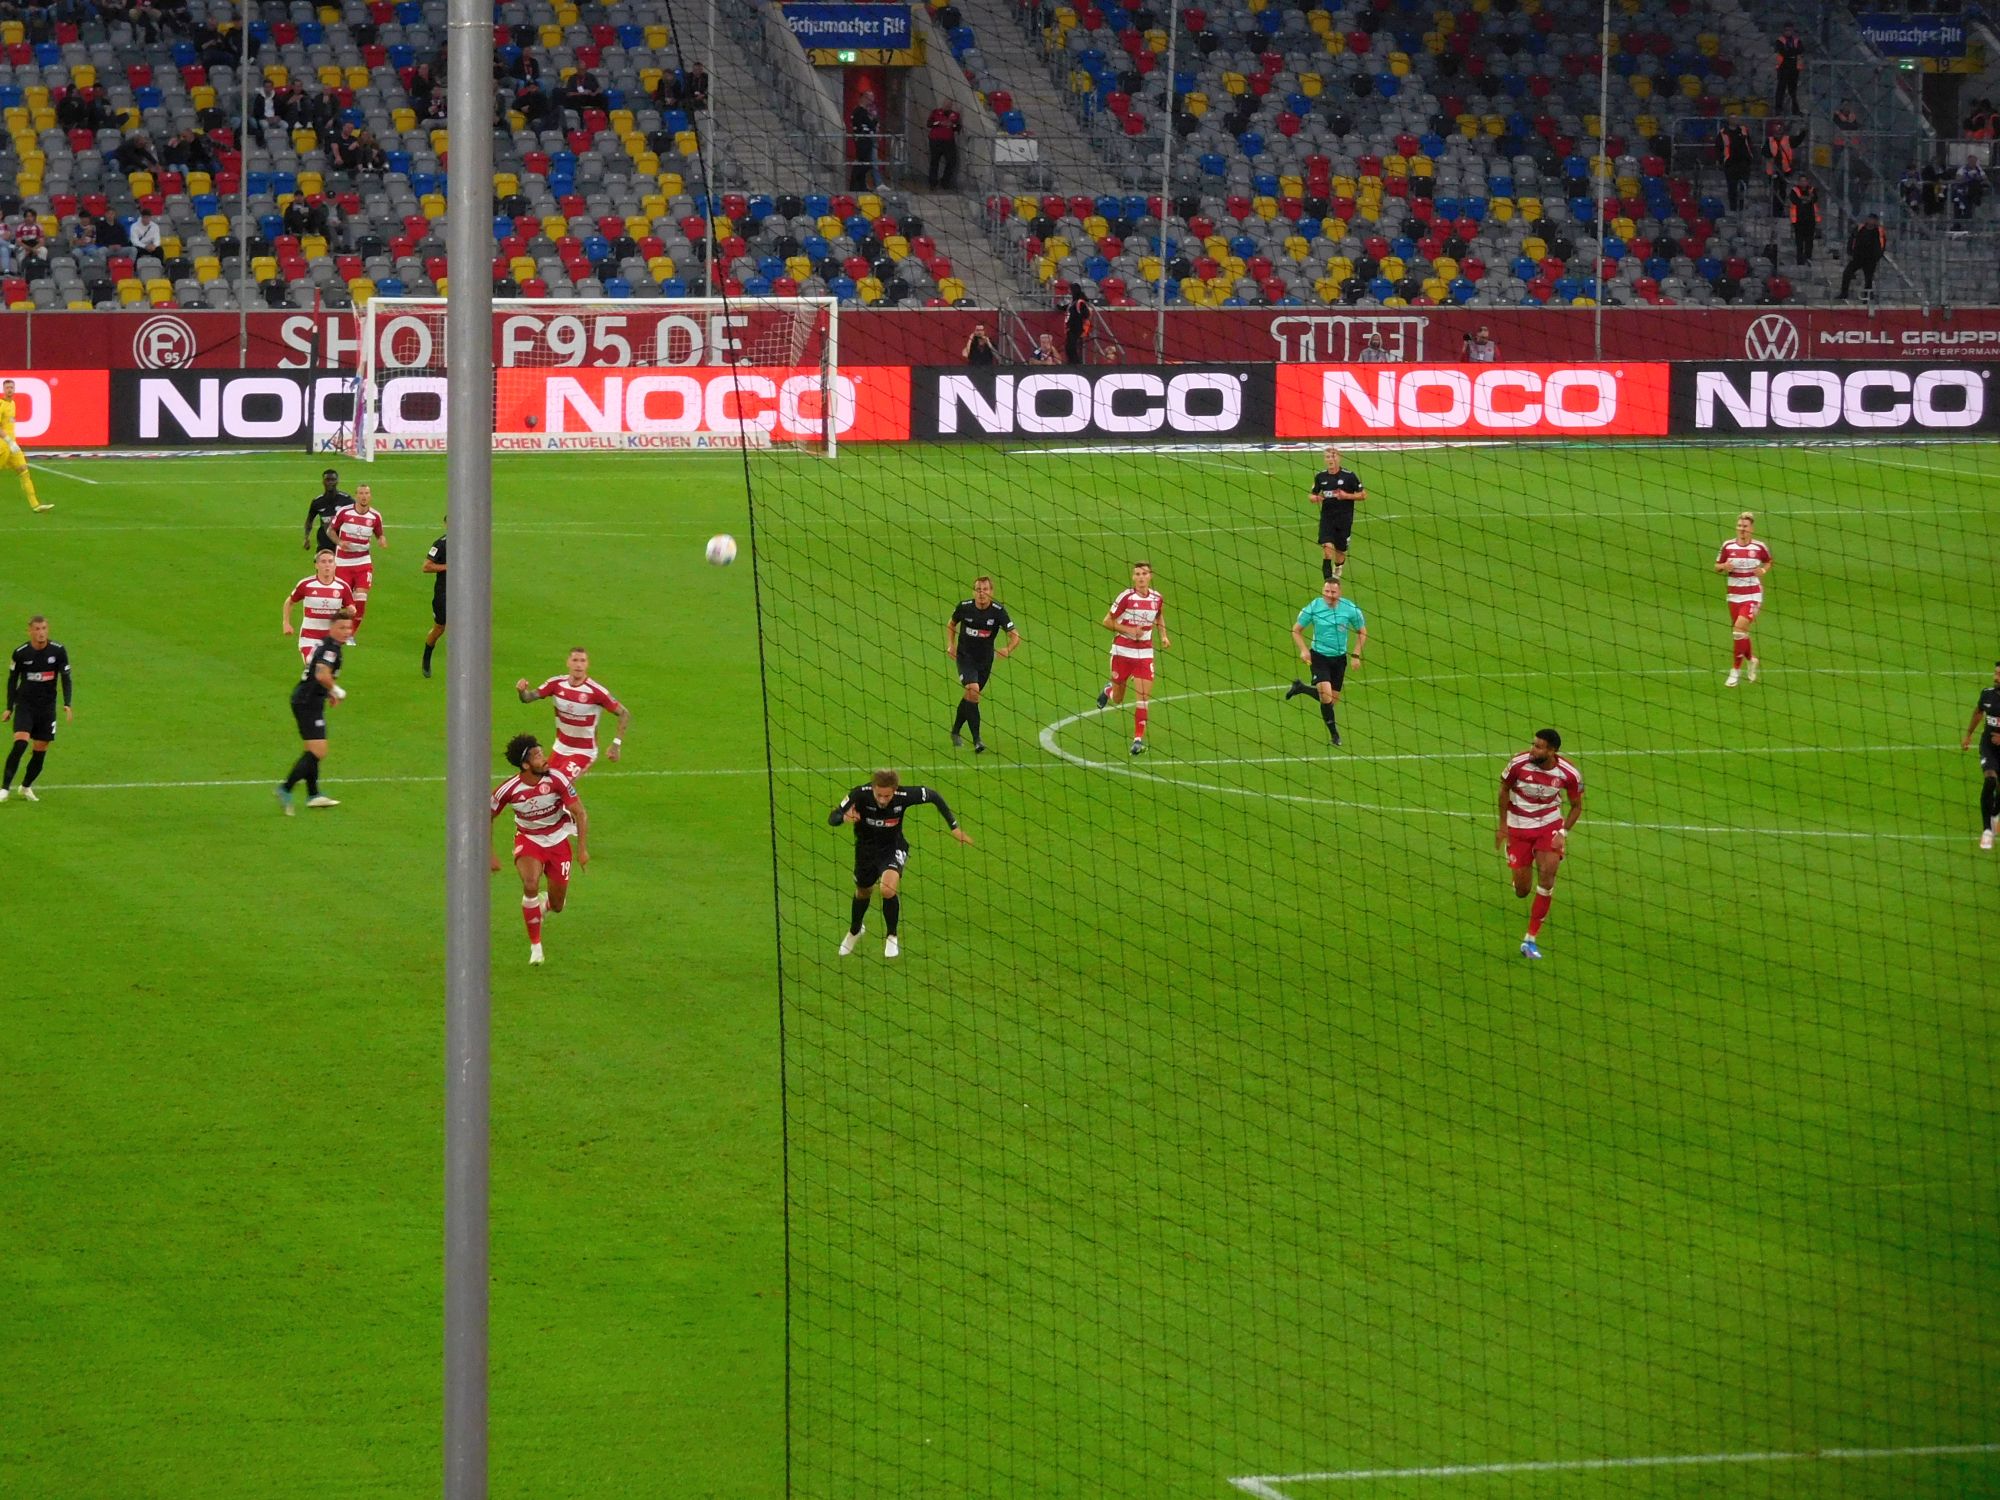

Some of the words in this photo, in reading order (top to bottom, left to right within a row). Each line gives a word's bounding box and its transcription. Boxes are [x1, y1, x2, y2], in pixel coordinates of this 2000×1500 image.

[787, 16, 879, 36] Schumacher
[883, 16, 906, 36] Alt
[878, 49, 895, 65] 17
[1820, 331, 1894, 344] MOLL
[1901, 331, 2000, 344] GRUPP
[164, 352, 181, 364] 95
[1901, 348, 1930, 357] AUTO
[1933, 348, 2000, 357] PERFORMAN
[545, 375, 856, 436] NOCO
[938, 372, 1242, 433] NOCO
[1322, 369, 1617, 428] NOCO
[1695, 369, 1984, 428] NOCO
[393, 438, 447, 450] AKTUE
[492, 437, 542, 449] ÜCHEN
[547, 436, 616, 448] AKTUELL
[628, 435, 691, 447] KÜCHEN
[697, 434, 765, 447] AKTUELL
[566, 760, 581, 777] 30
[560, 861, 571, 877] 19
